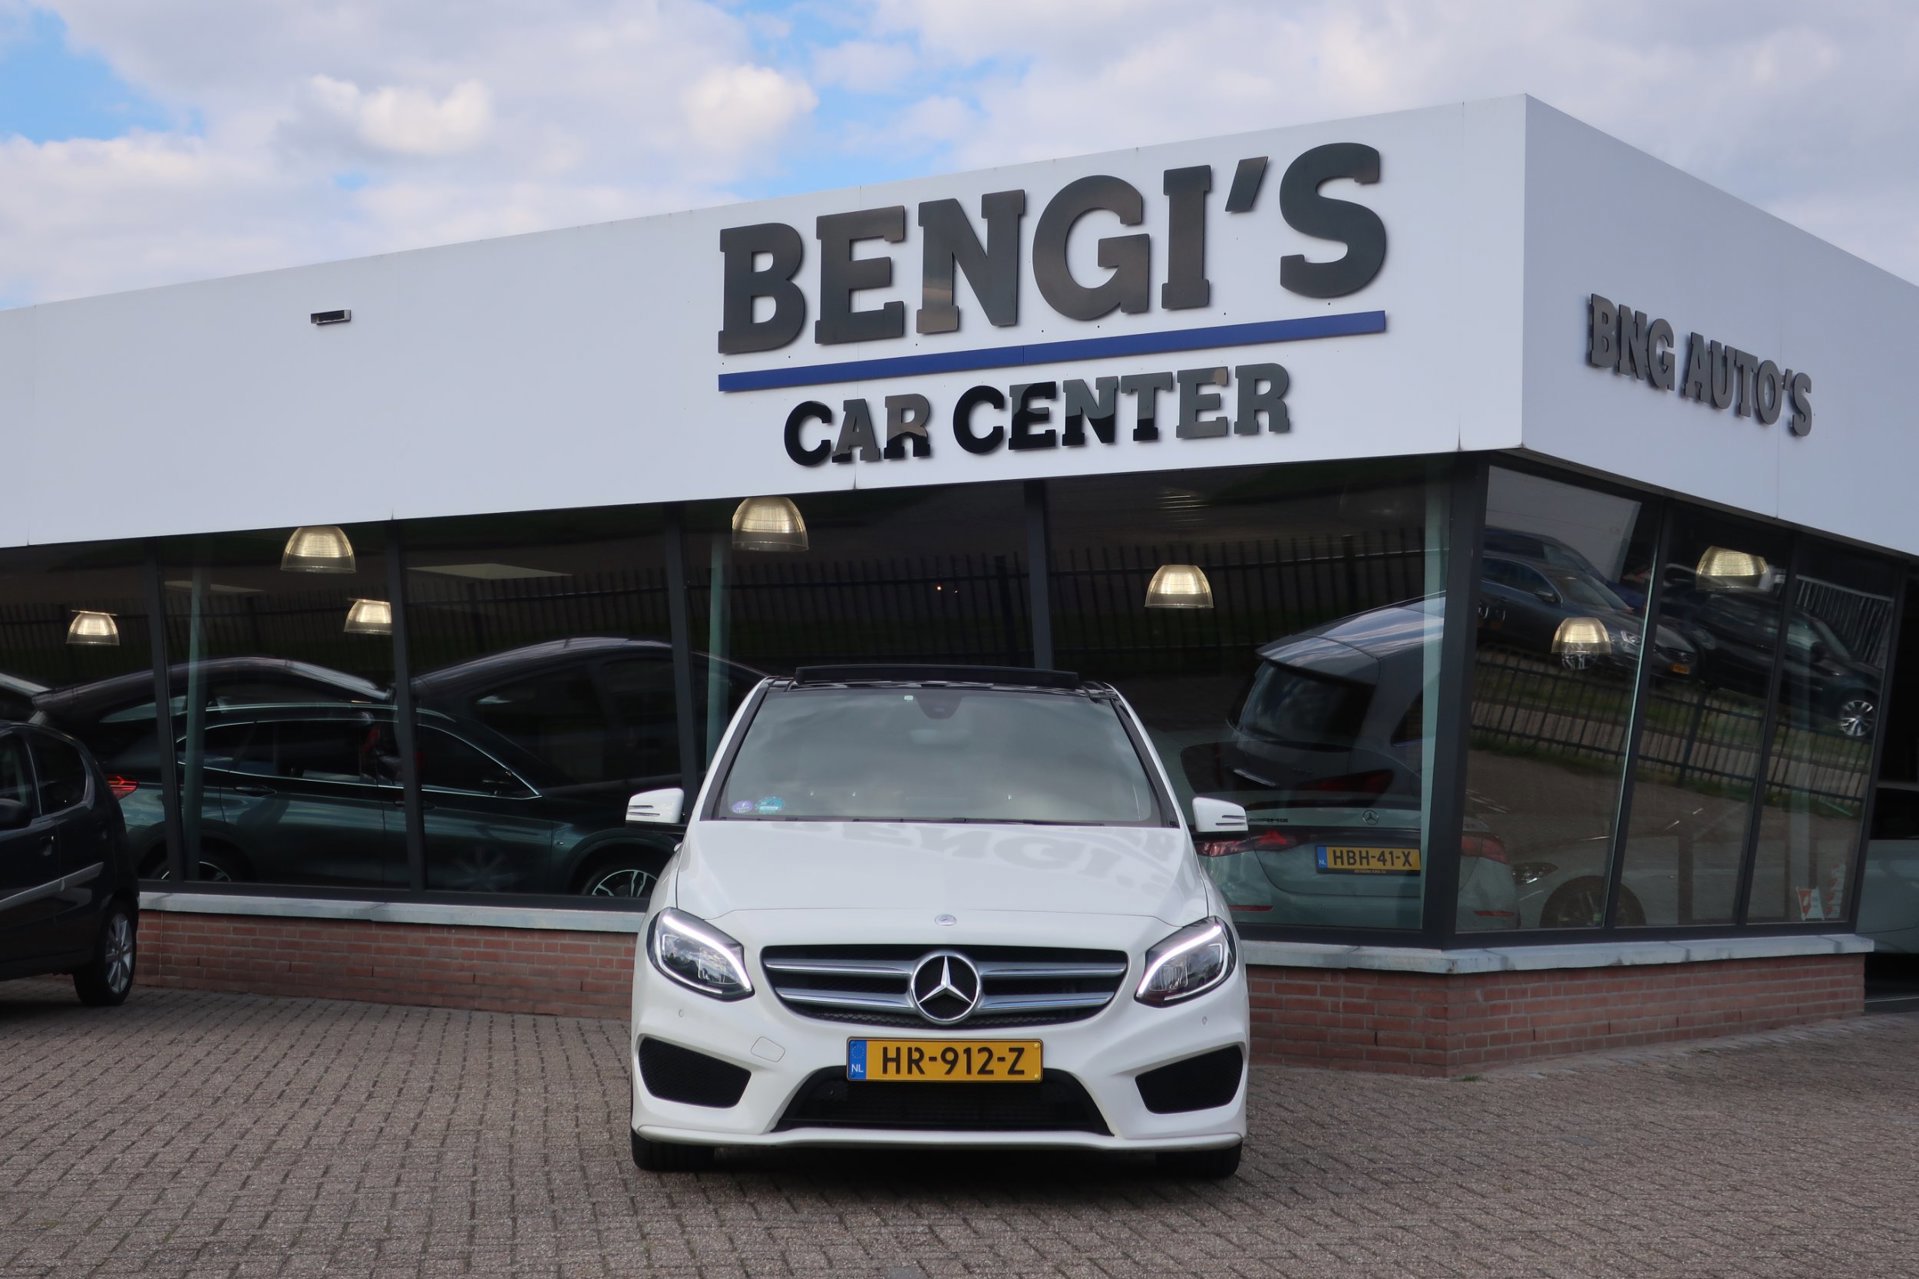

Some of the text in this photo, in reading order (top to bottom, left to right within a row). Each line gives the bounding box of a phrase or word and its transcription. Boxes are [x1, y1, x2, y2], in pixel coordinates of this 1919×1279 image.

[718, 142, 1387, 354] BENGI'S
[784, 362, 1290, 467] CAR CENTER
[1589, 293, 1812, 437] BNG AUTO'S
[1332, 849, 1413, 867] HBH-41-X
[851, 1046, 1026, 1075] NL HR-912-Z
